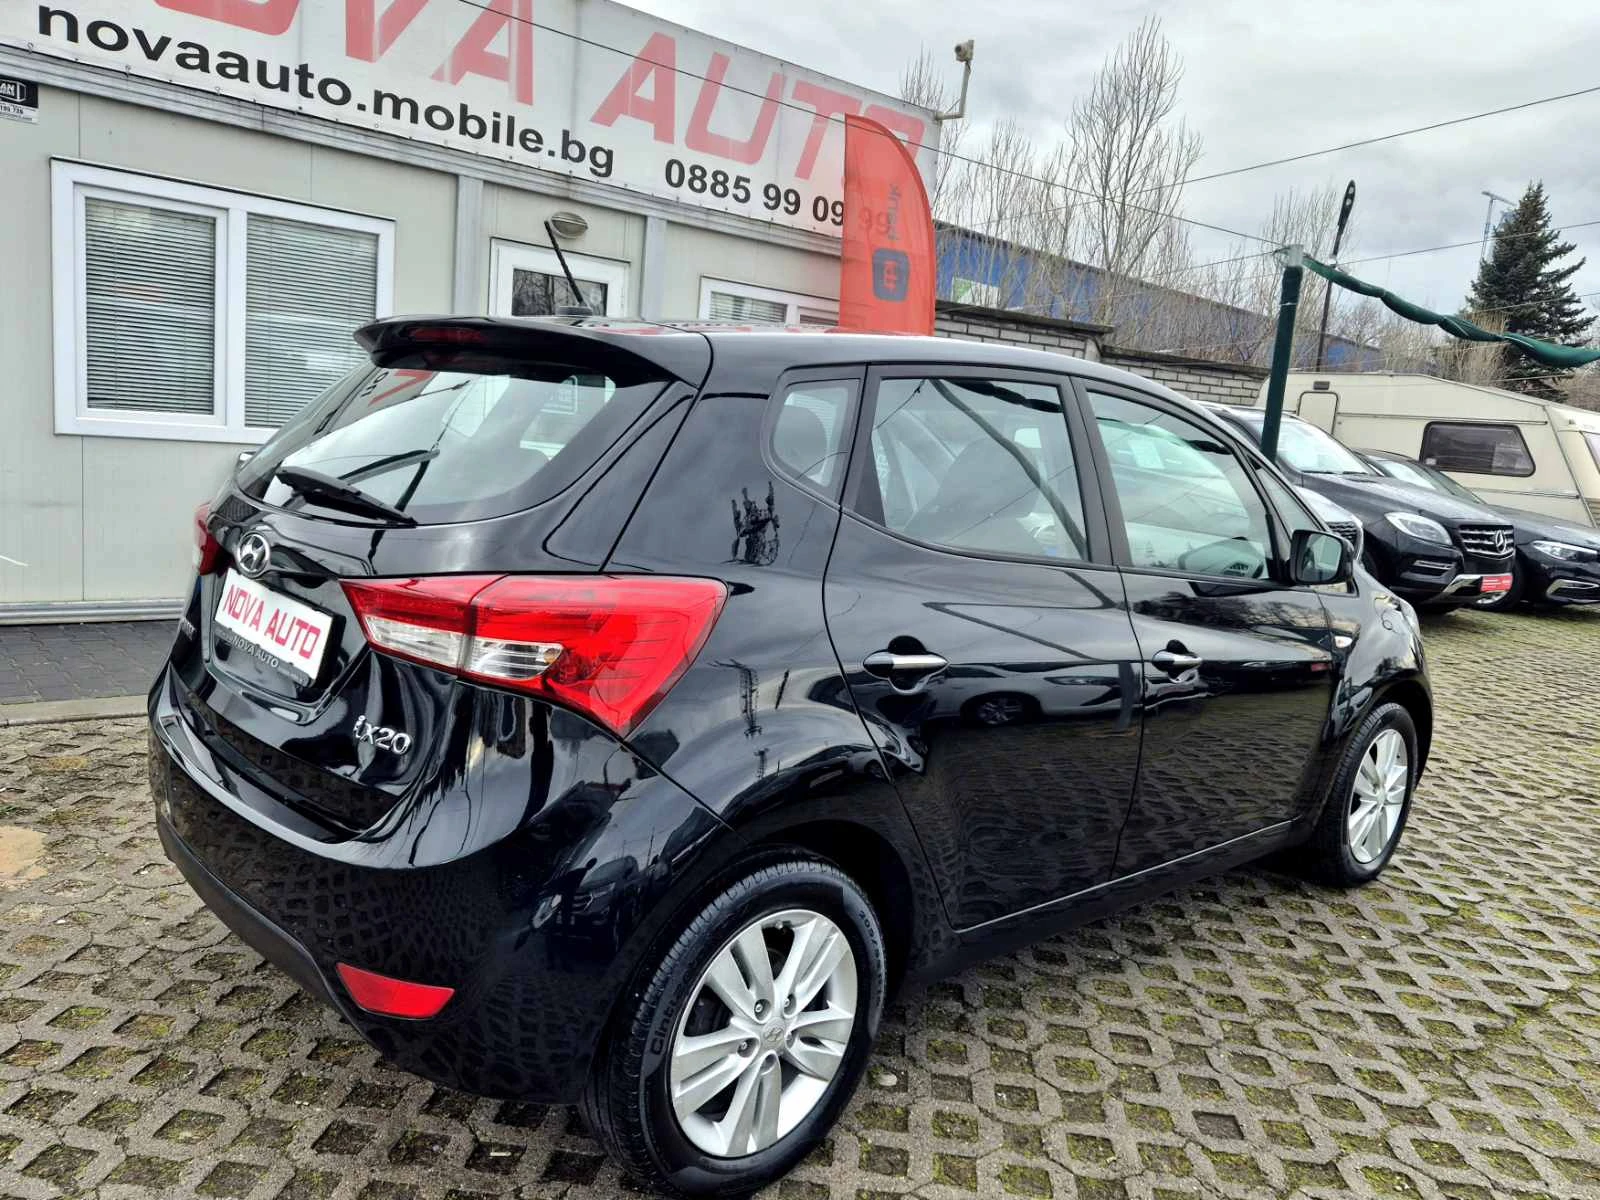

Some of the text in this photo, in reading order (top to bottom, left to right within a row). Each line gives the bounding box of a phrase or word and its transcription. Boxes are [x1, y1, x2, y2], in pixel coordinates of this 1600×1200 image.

[38, 5, 614, 178] novaauto.mobile.bg
[665, 158, 751, 204] 0885
[763, 183, 801, 216] 99
[812, 195, 844, 226] 09
[223, 584, 321, 659] NOVA AUTO
[232, 635, 279, 668] NOVA AUTO
[353, 714, 411, 755] ix20
